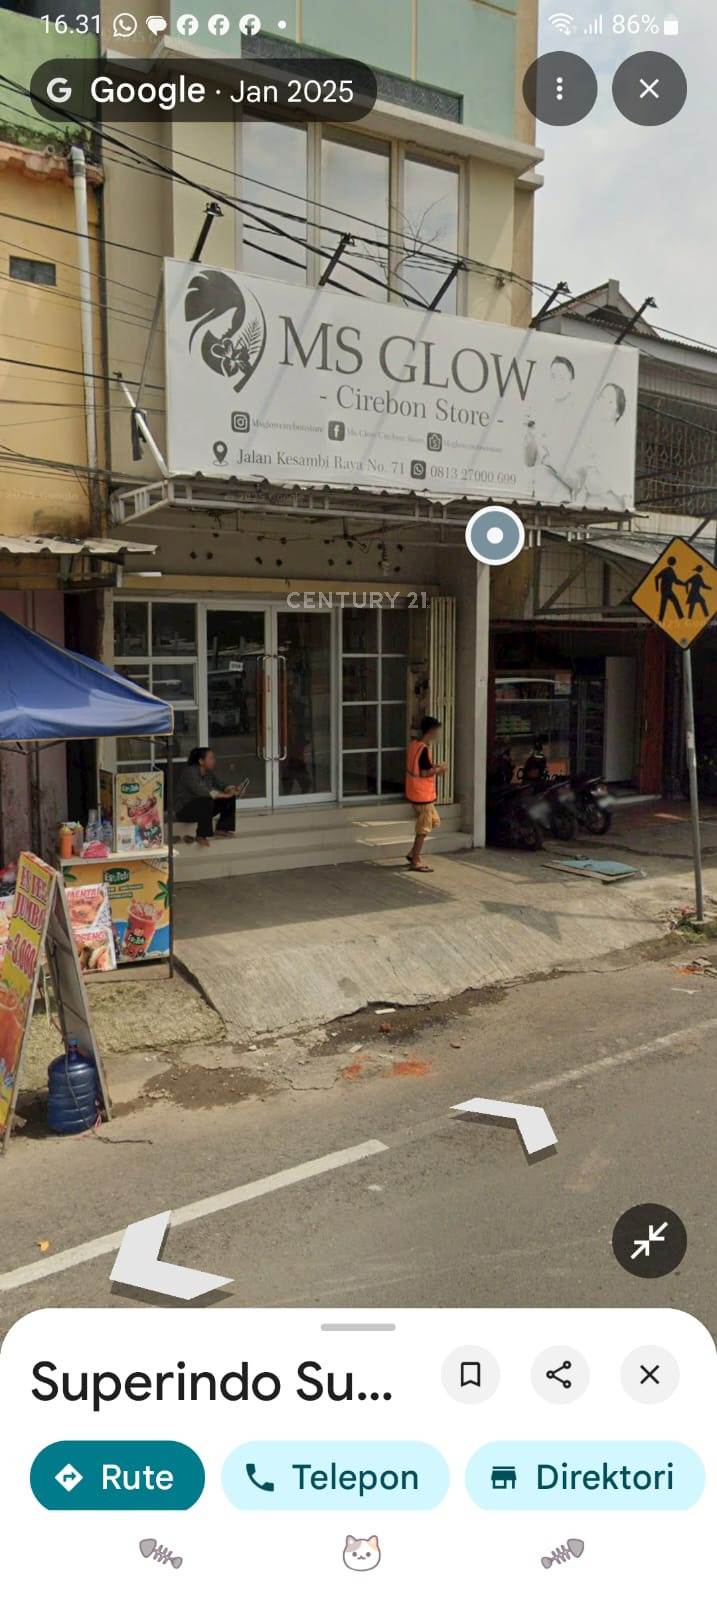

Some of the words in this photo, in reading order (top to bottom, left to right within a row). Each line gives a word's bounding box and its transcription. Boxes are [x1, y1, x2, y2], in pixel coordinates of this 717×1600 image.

[40, 14, 101, 35] 16.31
[612, 14, 660, 35] 86%
[90, 74, 206, 110] Google
[230, 80, 278, 103] Jan
[287, 79, 354, 103] 2025
[278, 315, 363, 375] MS
[379, 335, 537, 401] GLOW
[336, 384, 427, 419] Cirebon
[435, 397, 490, 428] Store
[237, 448, 272, 466] Jalan
[276, 451, 329, 469] Kesambi
[334, 455, 363, 473] Raya
[367, 458, 387, 474] No.
[391, 461, 405, 475] 71
[430, 465, 458, 479] 0813
[461, 467, 495, 483] 27000
[497, 471, 517, 485] 699
[31, 1360, 281, 1413] Superindo
[296, 1360, 392, 1402] Su...
[102, 1463, 174, 1491] Rute
[291, 1463, 419, 1497] Telepon
[537, 1462, 674, 1491] Direktori
